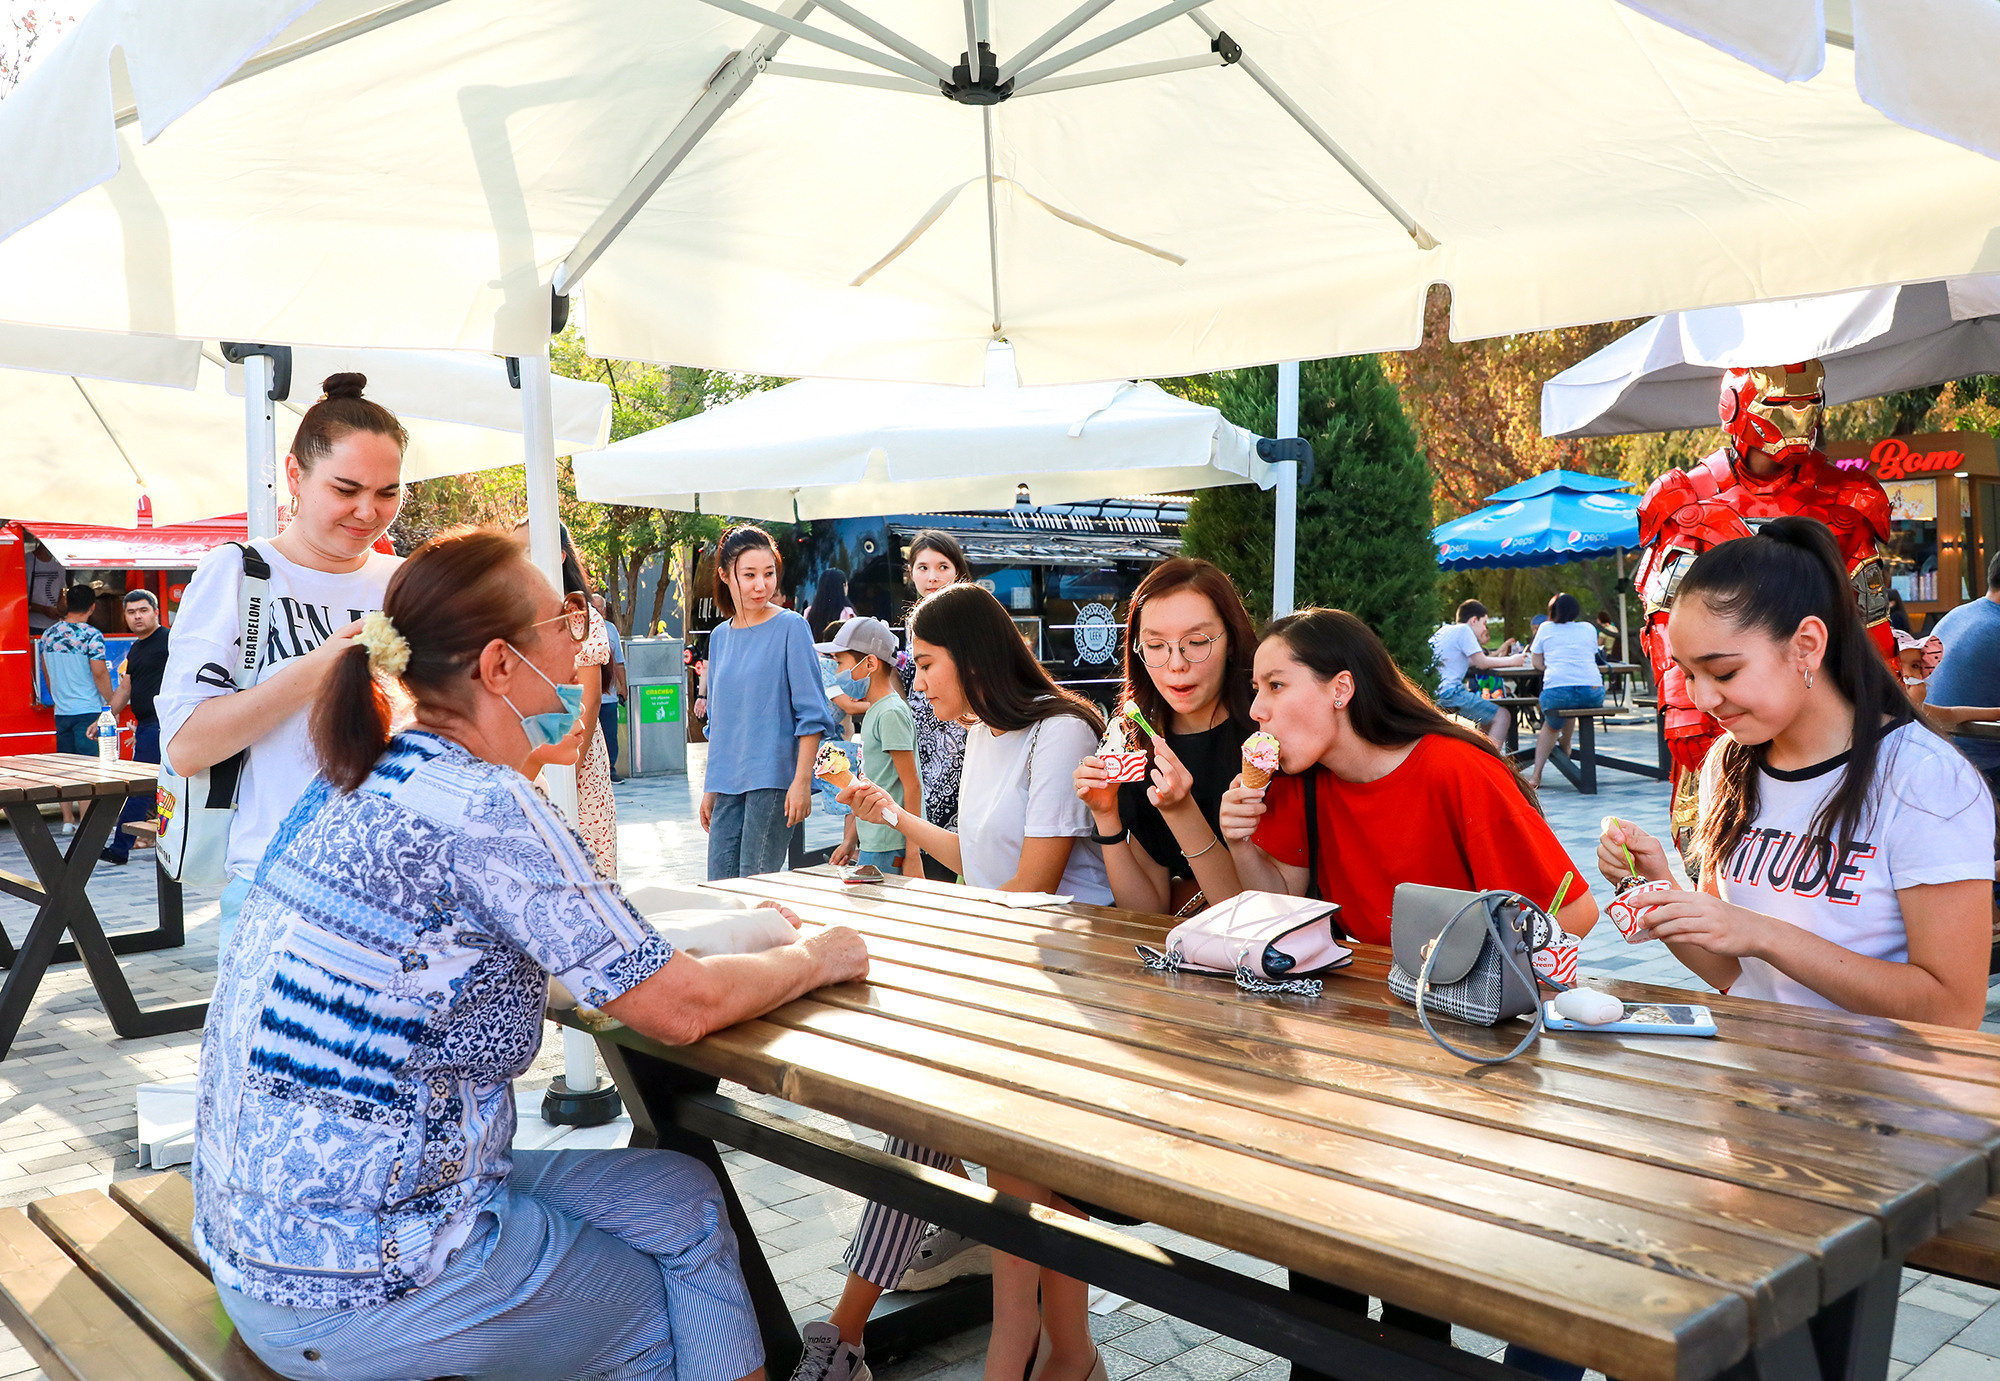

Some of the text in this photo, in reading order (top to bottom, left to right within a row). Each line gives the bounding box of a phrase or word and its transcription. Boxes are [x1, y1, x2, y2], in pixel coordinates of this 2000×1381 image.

[1869, 438, 1965, 480] Bom
[1582, 531, 1609, 543] pepsi
[244, 597, 261, 670] FCBARCELONA
